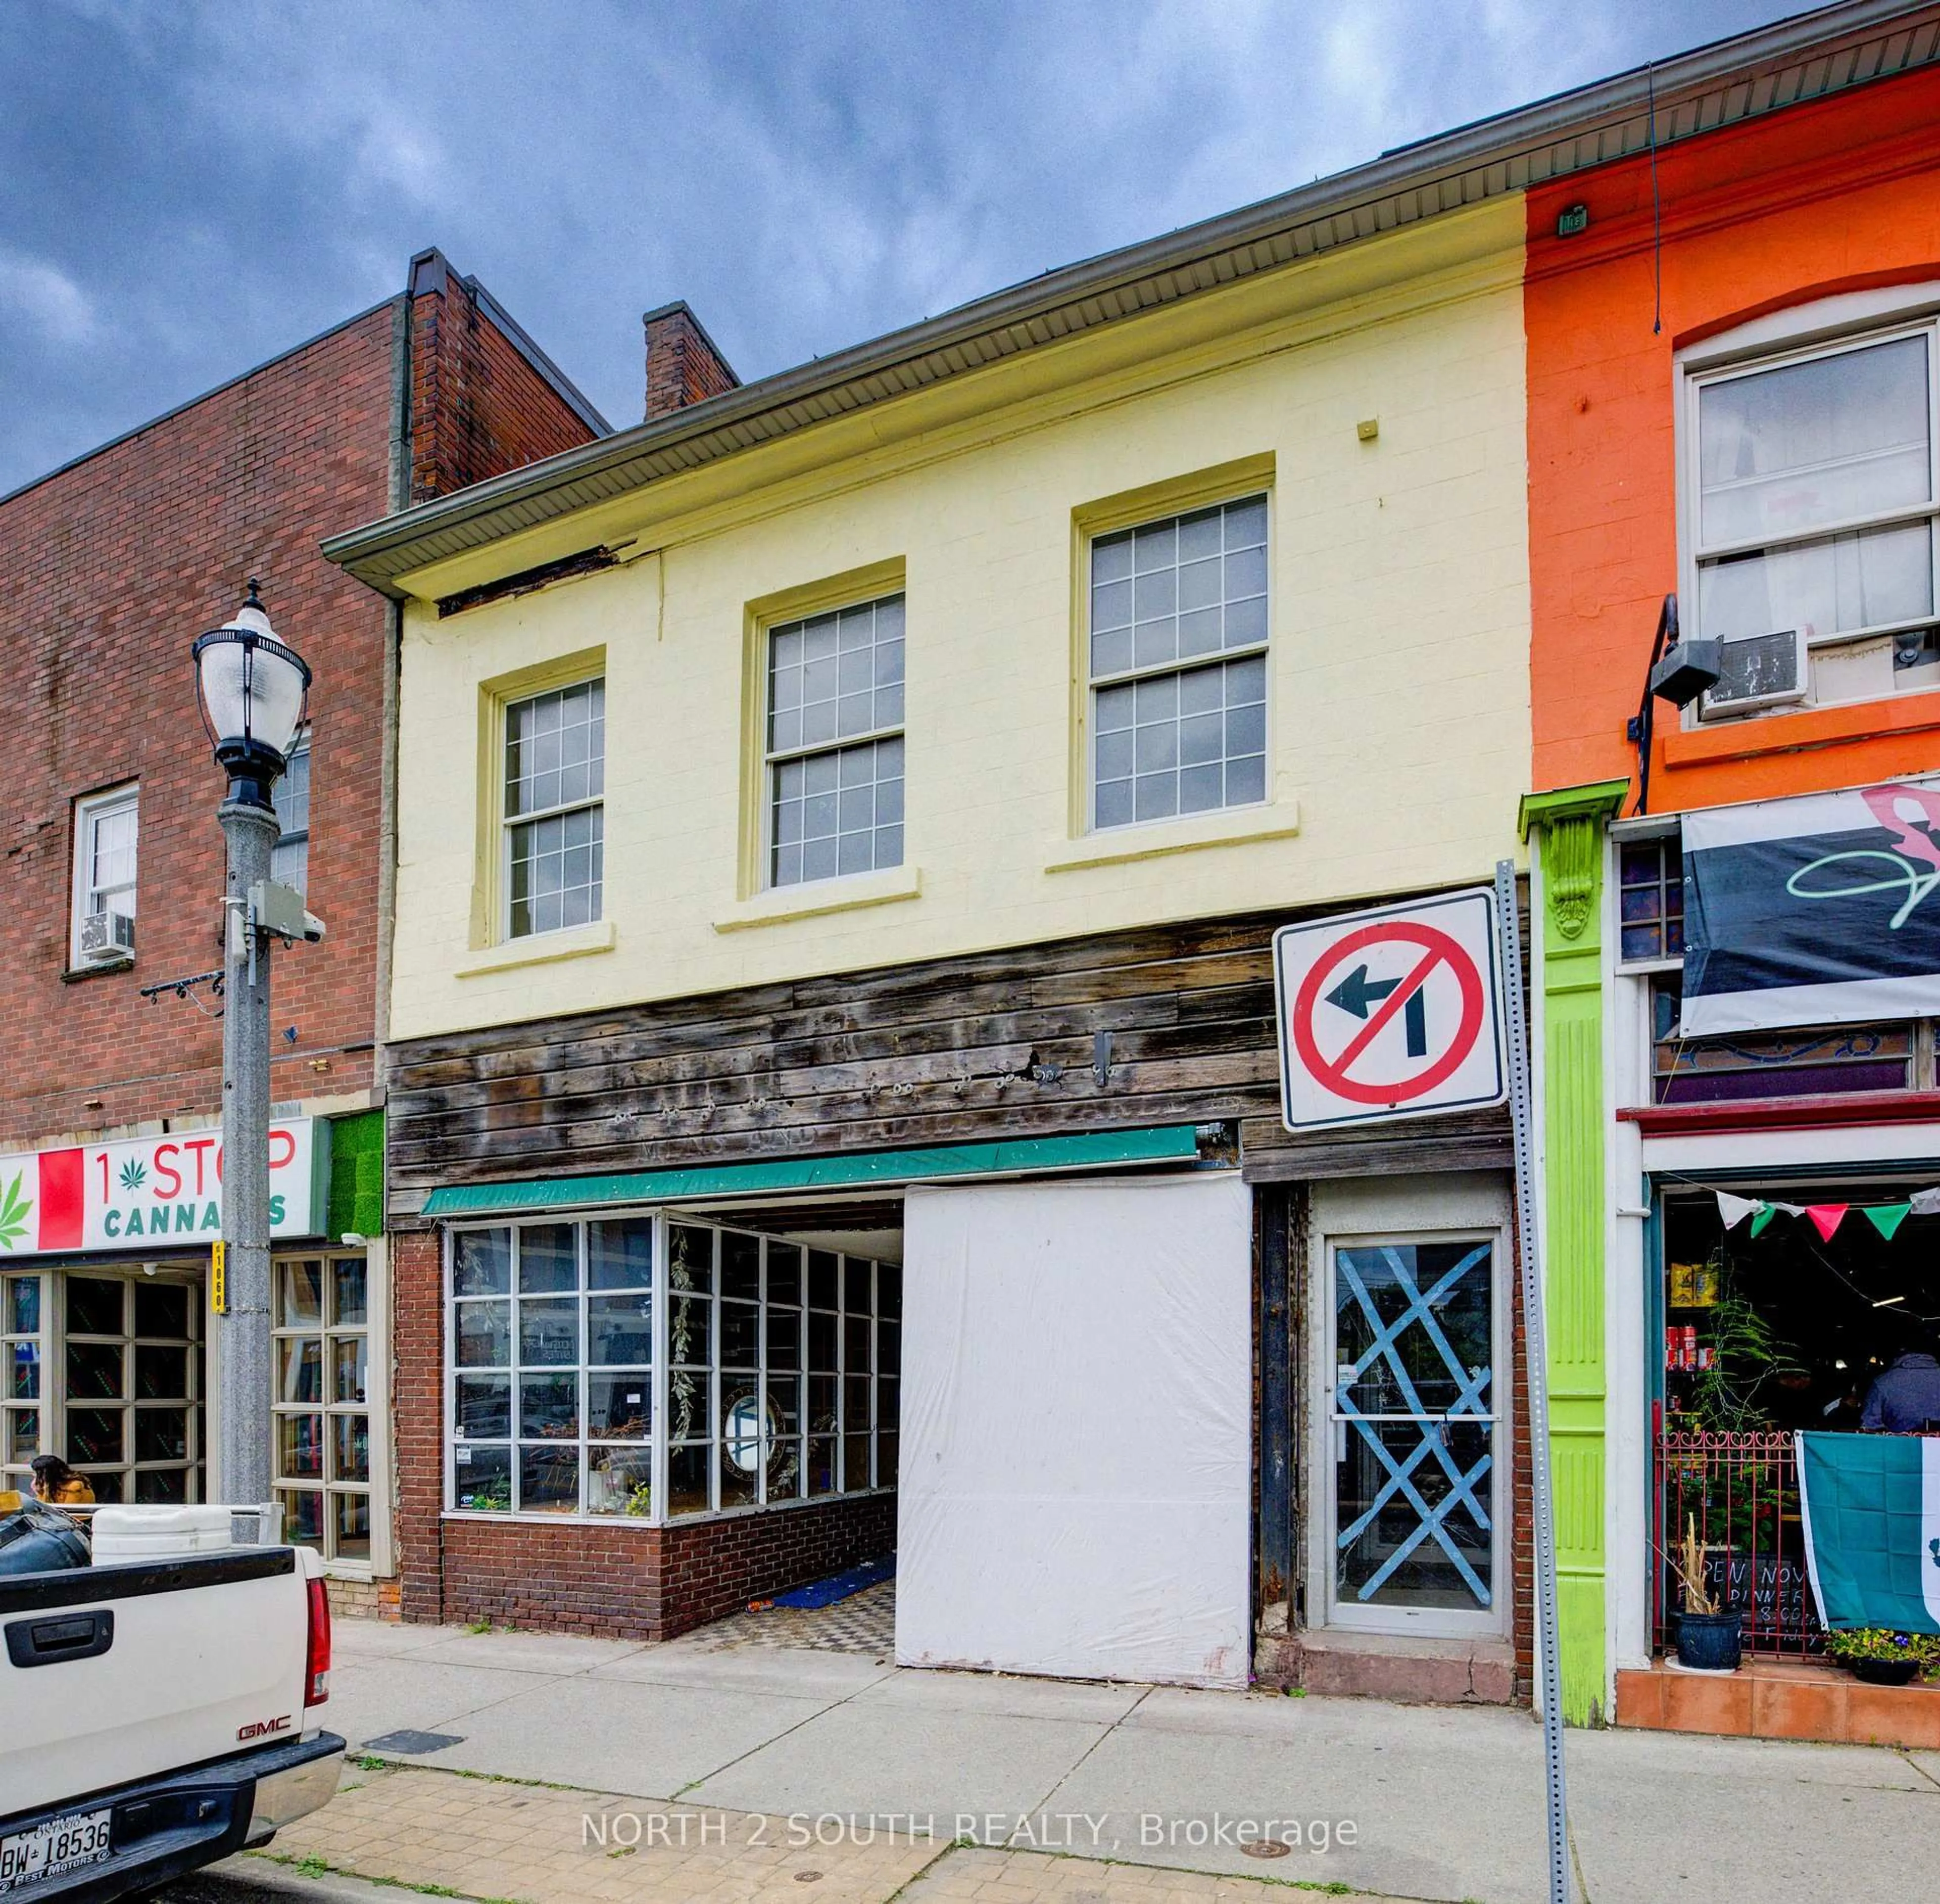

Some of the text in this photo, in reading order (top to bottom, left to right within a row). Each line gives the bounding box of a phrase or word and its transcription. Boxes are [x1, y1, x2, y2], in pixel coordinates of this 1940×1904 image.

[96, 1130, 296, 1204] 1 STP
[104, 1195, 286, 1237] CANNAS
[237, 1715, 292, 1741] GMC
[43, 1821, 109, 1865] 18536
[14, 1871, 44, 1887] BEST
[47, 1854, 94, 1876] MOTORS
